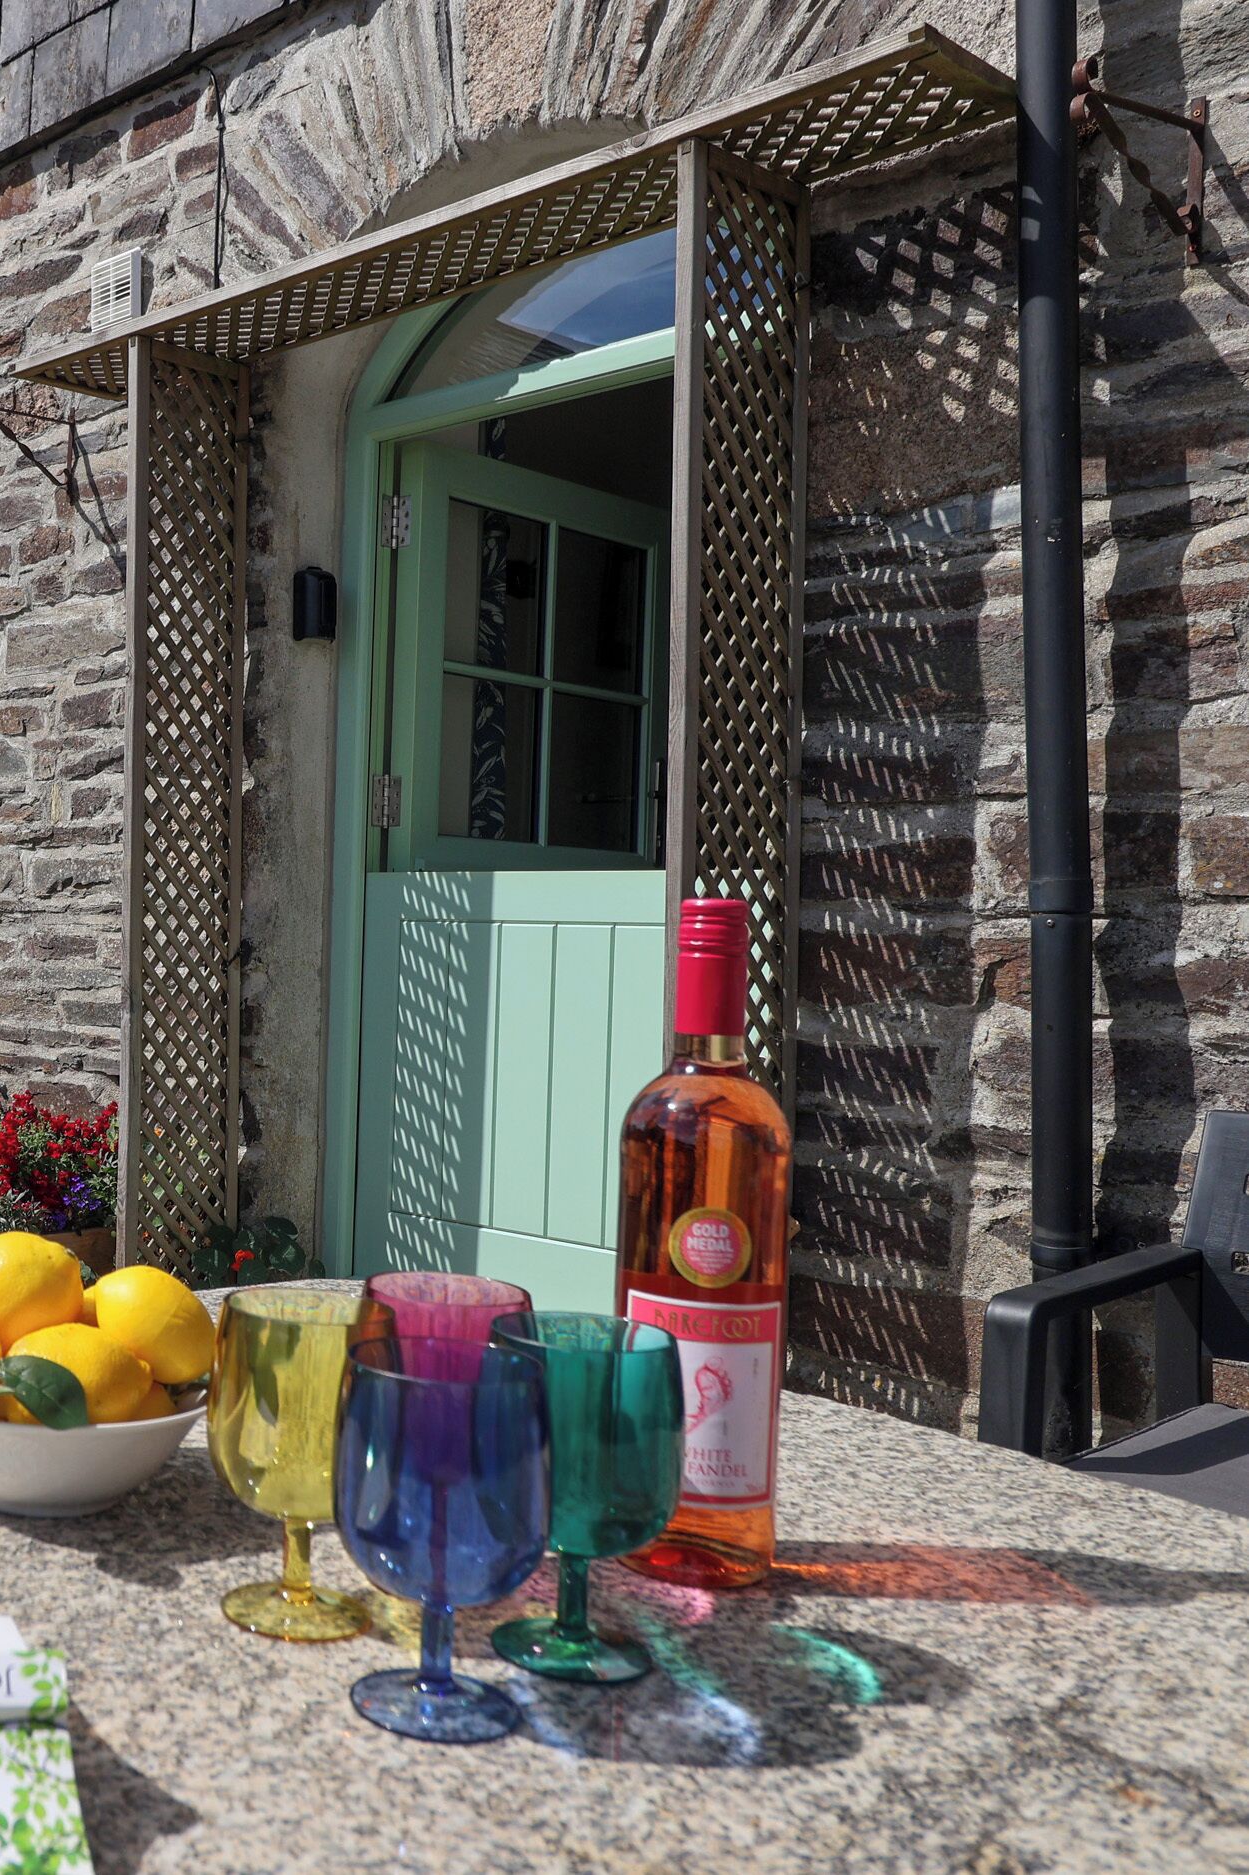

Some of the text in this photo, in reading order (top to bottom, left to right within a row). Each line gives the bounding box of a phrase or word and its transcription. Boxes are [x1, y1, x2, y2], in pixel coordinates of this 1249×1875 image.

[692, 1223, 729, 1238] GOLD
[687, 1236, 734, 1252] MEDAL
[654, 1309, 761, 1339] BAREFOOT
[687, 1462, 748, 1478] FANDEL
